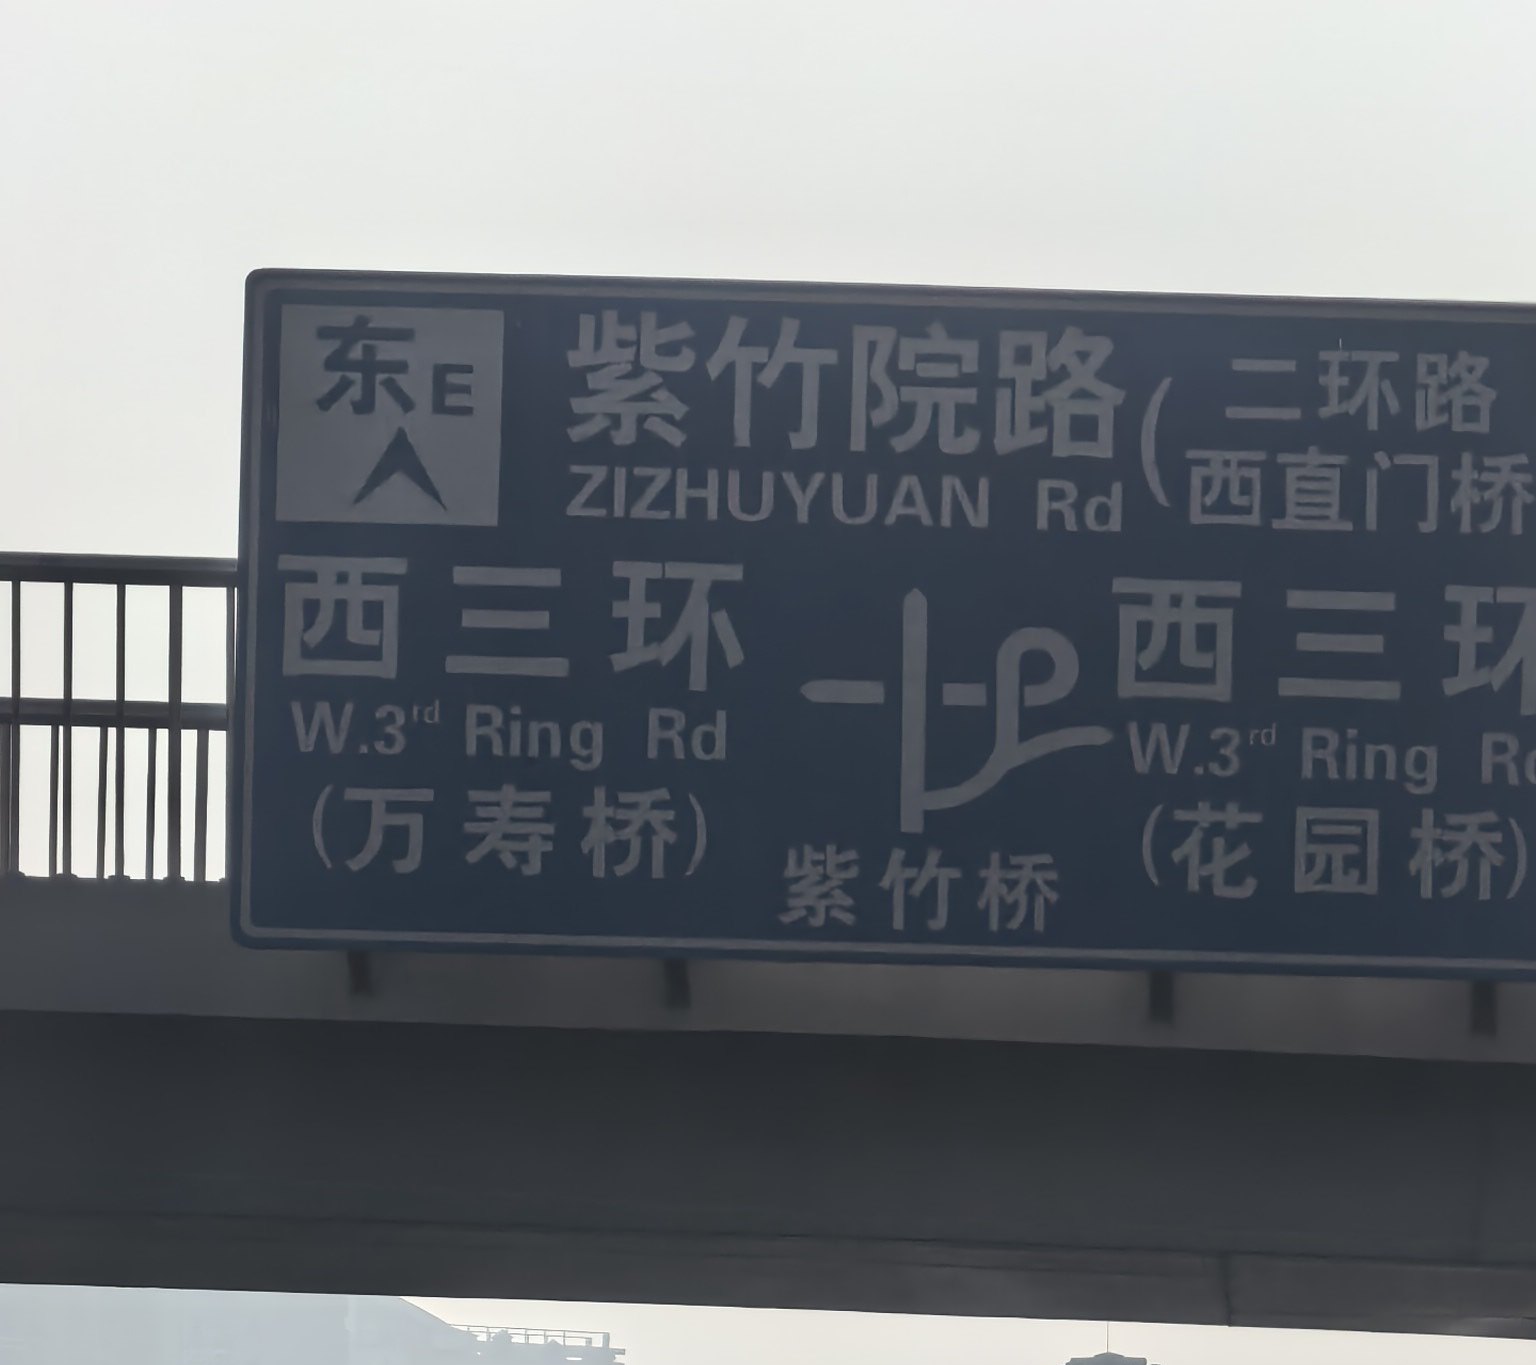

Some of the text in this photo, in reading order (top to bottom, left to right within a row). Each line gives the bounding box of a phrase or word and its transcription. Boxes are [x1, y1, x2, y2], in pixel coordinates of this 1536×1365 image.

[315, 314, 475, 418] 东 E
[565, 309, 1127, 460] 紫竹院路
[1224, 347, 1498, 436] 二环路
[565, 465, 1124, 534] ZIZHUYUAN Rd
[1185, 445, 1536, 537] 西直门桥
[277, 554, 745, 693] 西三环
[289, 698, 727, 772] W.3rd Ring Rd
[1126, 720, 1278, 779] W.3rd
[1300, 725, 1439, 796] Ring
[778, 842, 1060, 934] 紫竹桥
